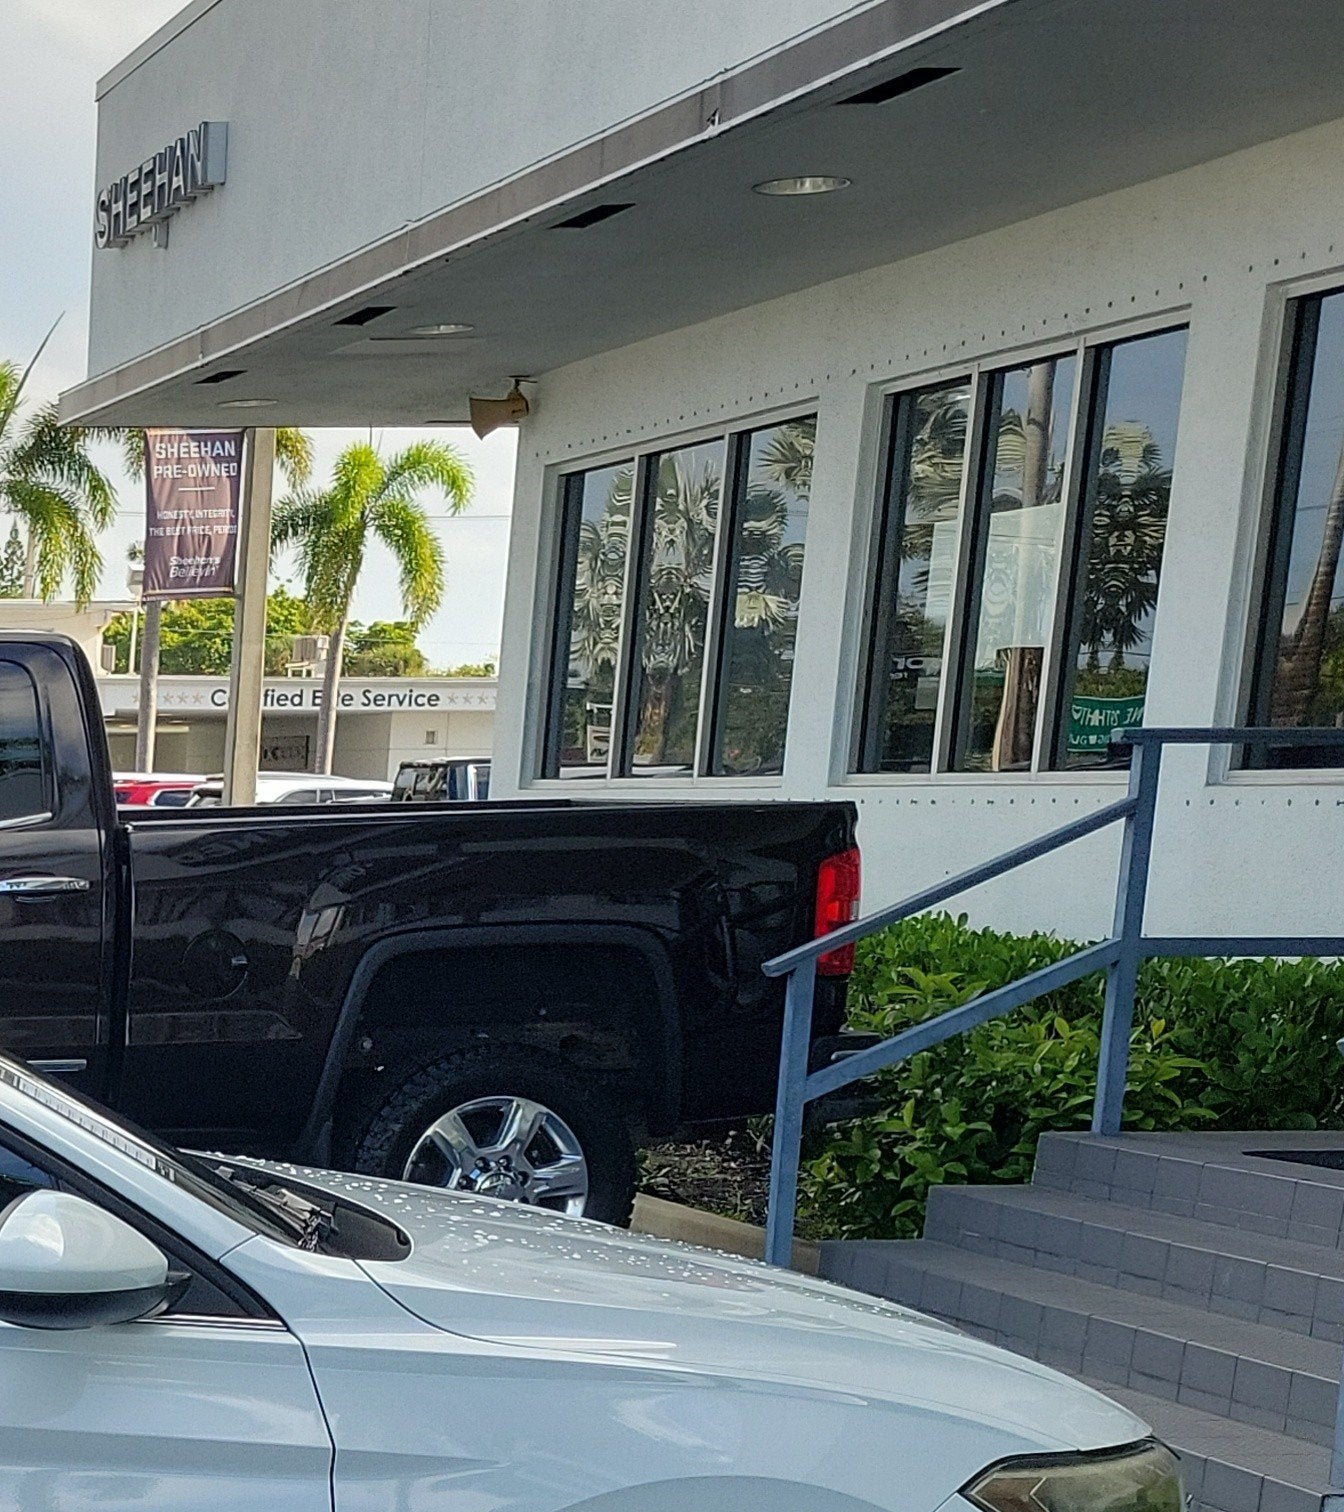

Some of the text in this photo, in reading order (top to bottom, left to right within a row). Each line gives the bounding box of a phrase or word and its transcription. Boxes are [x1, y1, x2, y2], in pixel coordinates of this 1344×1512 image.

[95, 121, 228, 249] SHEEHAN
[155, 440, 236, 458] SHEEHAN
[153, 462, 238, 478] PRE-OWNED
[149, 527, 165, 537] THE
[361, 688, 440, 707] Service
